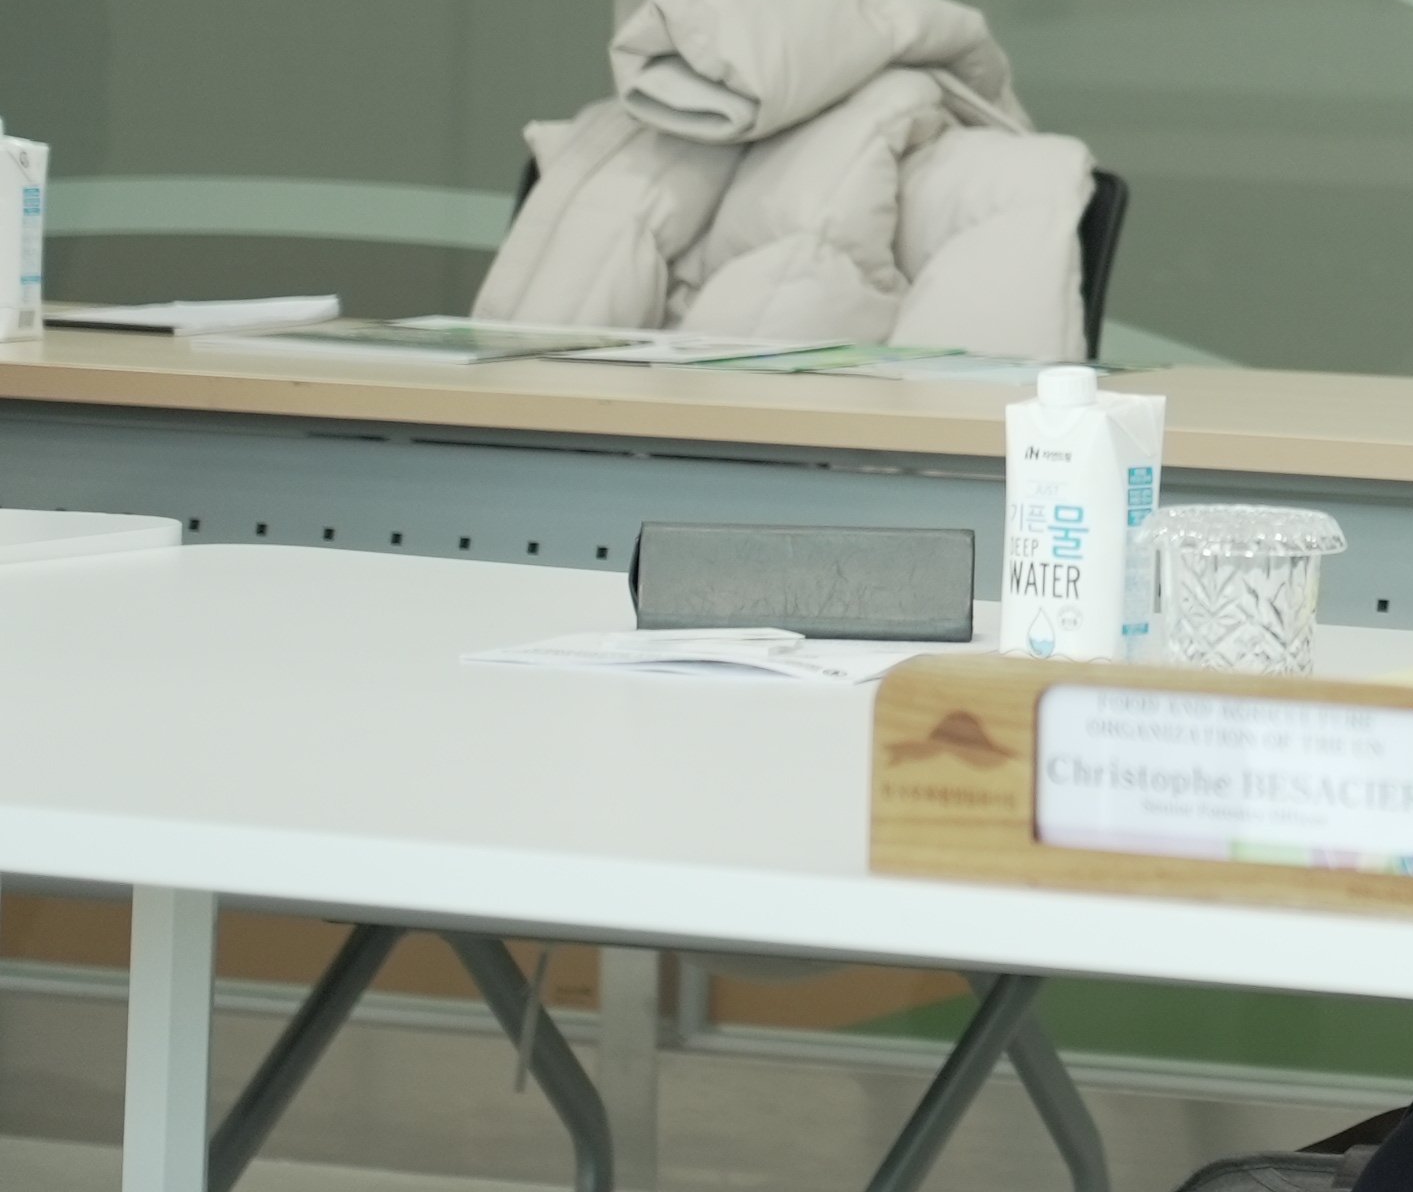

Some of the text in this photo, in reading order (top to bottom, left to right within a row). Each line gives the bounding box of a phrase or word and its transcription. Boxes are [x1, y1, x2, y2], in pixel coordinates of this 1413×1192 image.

[1047, 504, 1090, 560] 물
[1009, 559, 1082, 600] WATER
[1097, 693, 1160, 715] FOOD
[1085, 716, 1256, 748] ORGANIZATION
[1262, 731, 1291, 753] OF
[1047, 753, 1231, 798] Christophe
